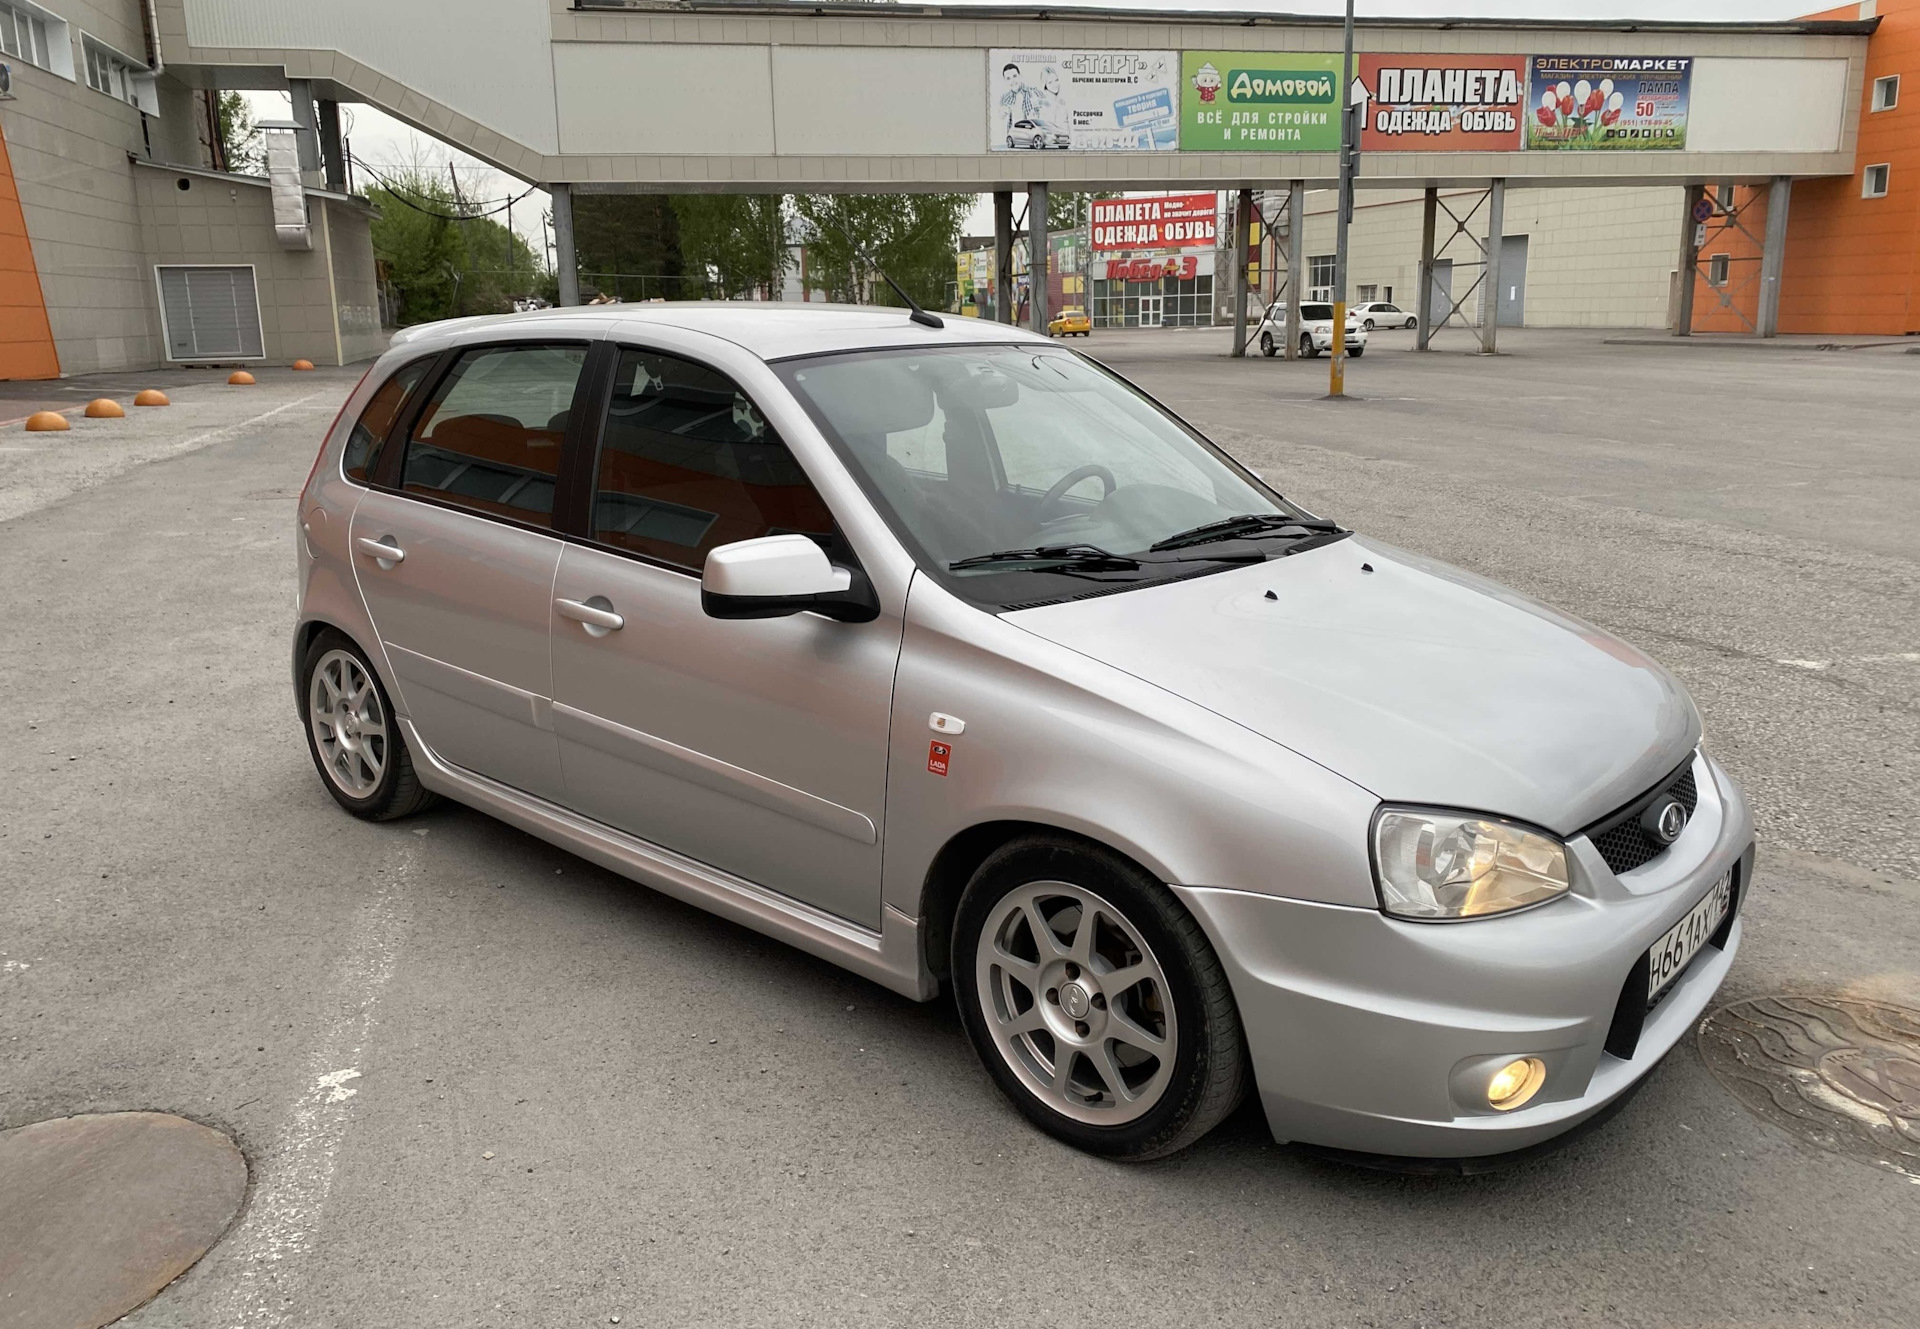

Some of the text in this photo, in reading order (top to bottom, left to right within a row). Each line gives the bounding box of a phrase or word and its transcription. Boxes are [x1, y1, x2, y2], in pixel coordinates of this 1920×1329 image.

[1536, 58, 1689, 70] ЭЛЕКТРОМАРКЕТ
[1379, 68, 1518, 103] ПЛАНЕТА
[1638, 82, 1679, 93] ЛАМПА
[1636, 102, 1654, 117] 50
[1197, 109, 1327, 127] ВСЁ ДЛЯ СТРОЙКИ
[1377, 111, 1516, 133] ОДЕЖДА ОБУВЬ
[1223, 128, 1301, 140] И РЕМОНТА
[1095, 202, 1161, 223] ПЛАНЕТА
[1094, 224, 1158, 246] ОДЕЖДА
[1164, 220, 1215, 240] ОБУВЬ
[930, 759, 946, 769] LADA
